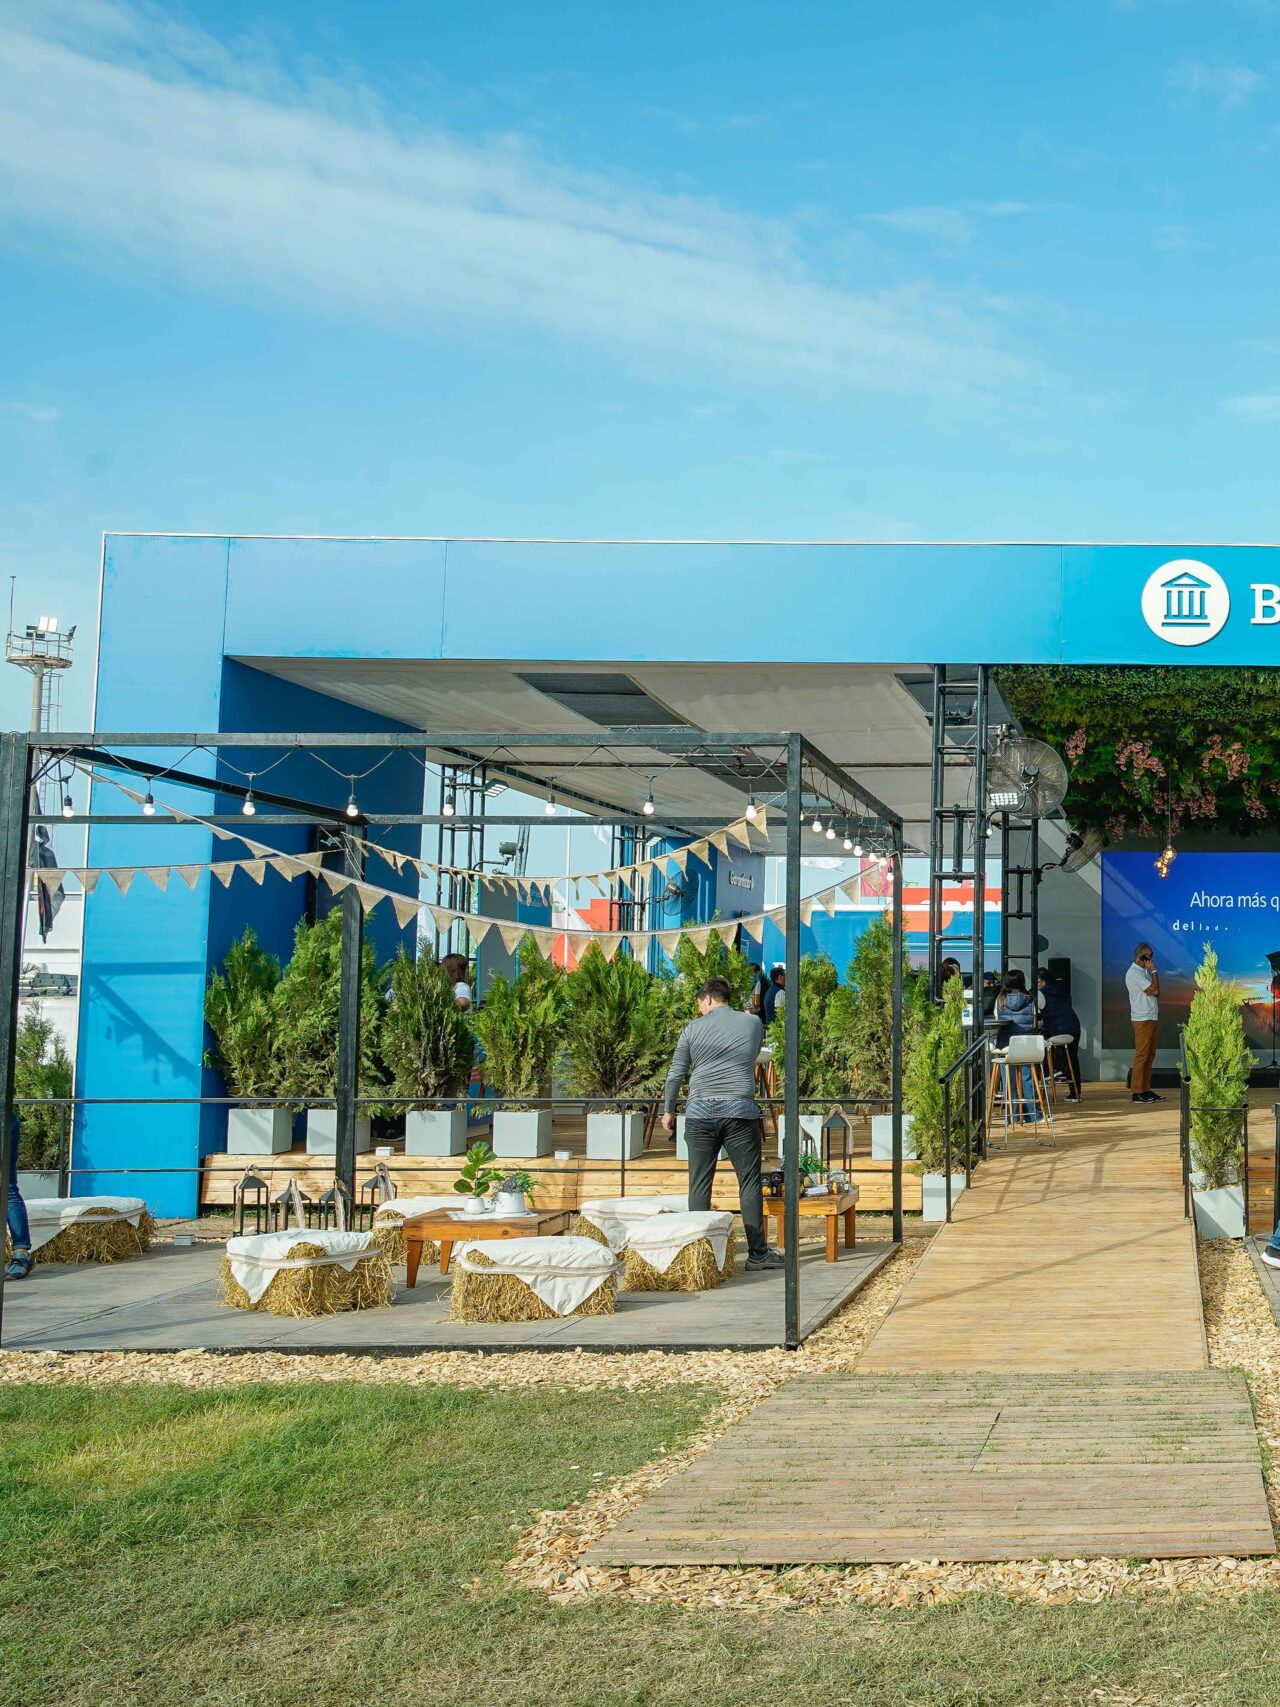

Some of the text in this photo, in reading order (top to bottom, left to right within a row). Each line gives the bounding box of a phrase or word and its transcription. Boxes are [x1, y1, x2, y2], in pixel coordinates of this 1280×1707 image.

[1190, 890, 1234, 908] Ahora
[1238, 891, 1267, 908] más
[1172, 919, 1194, 931] del
